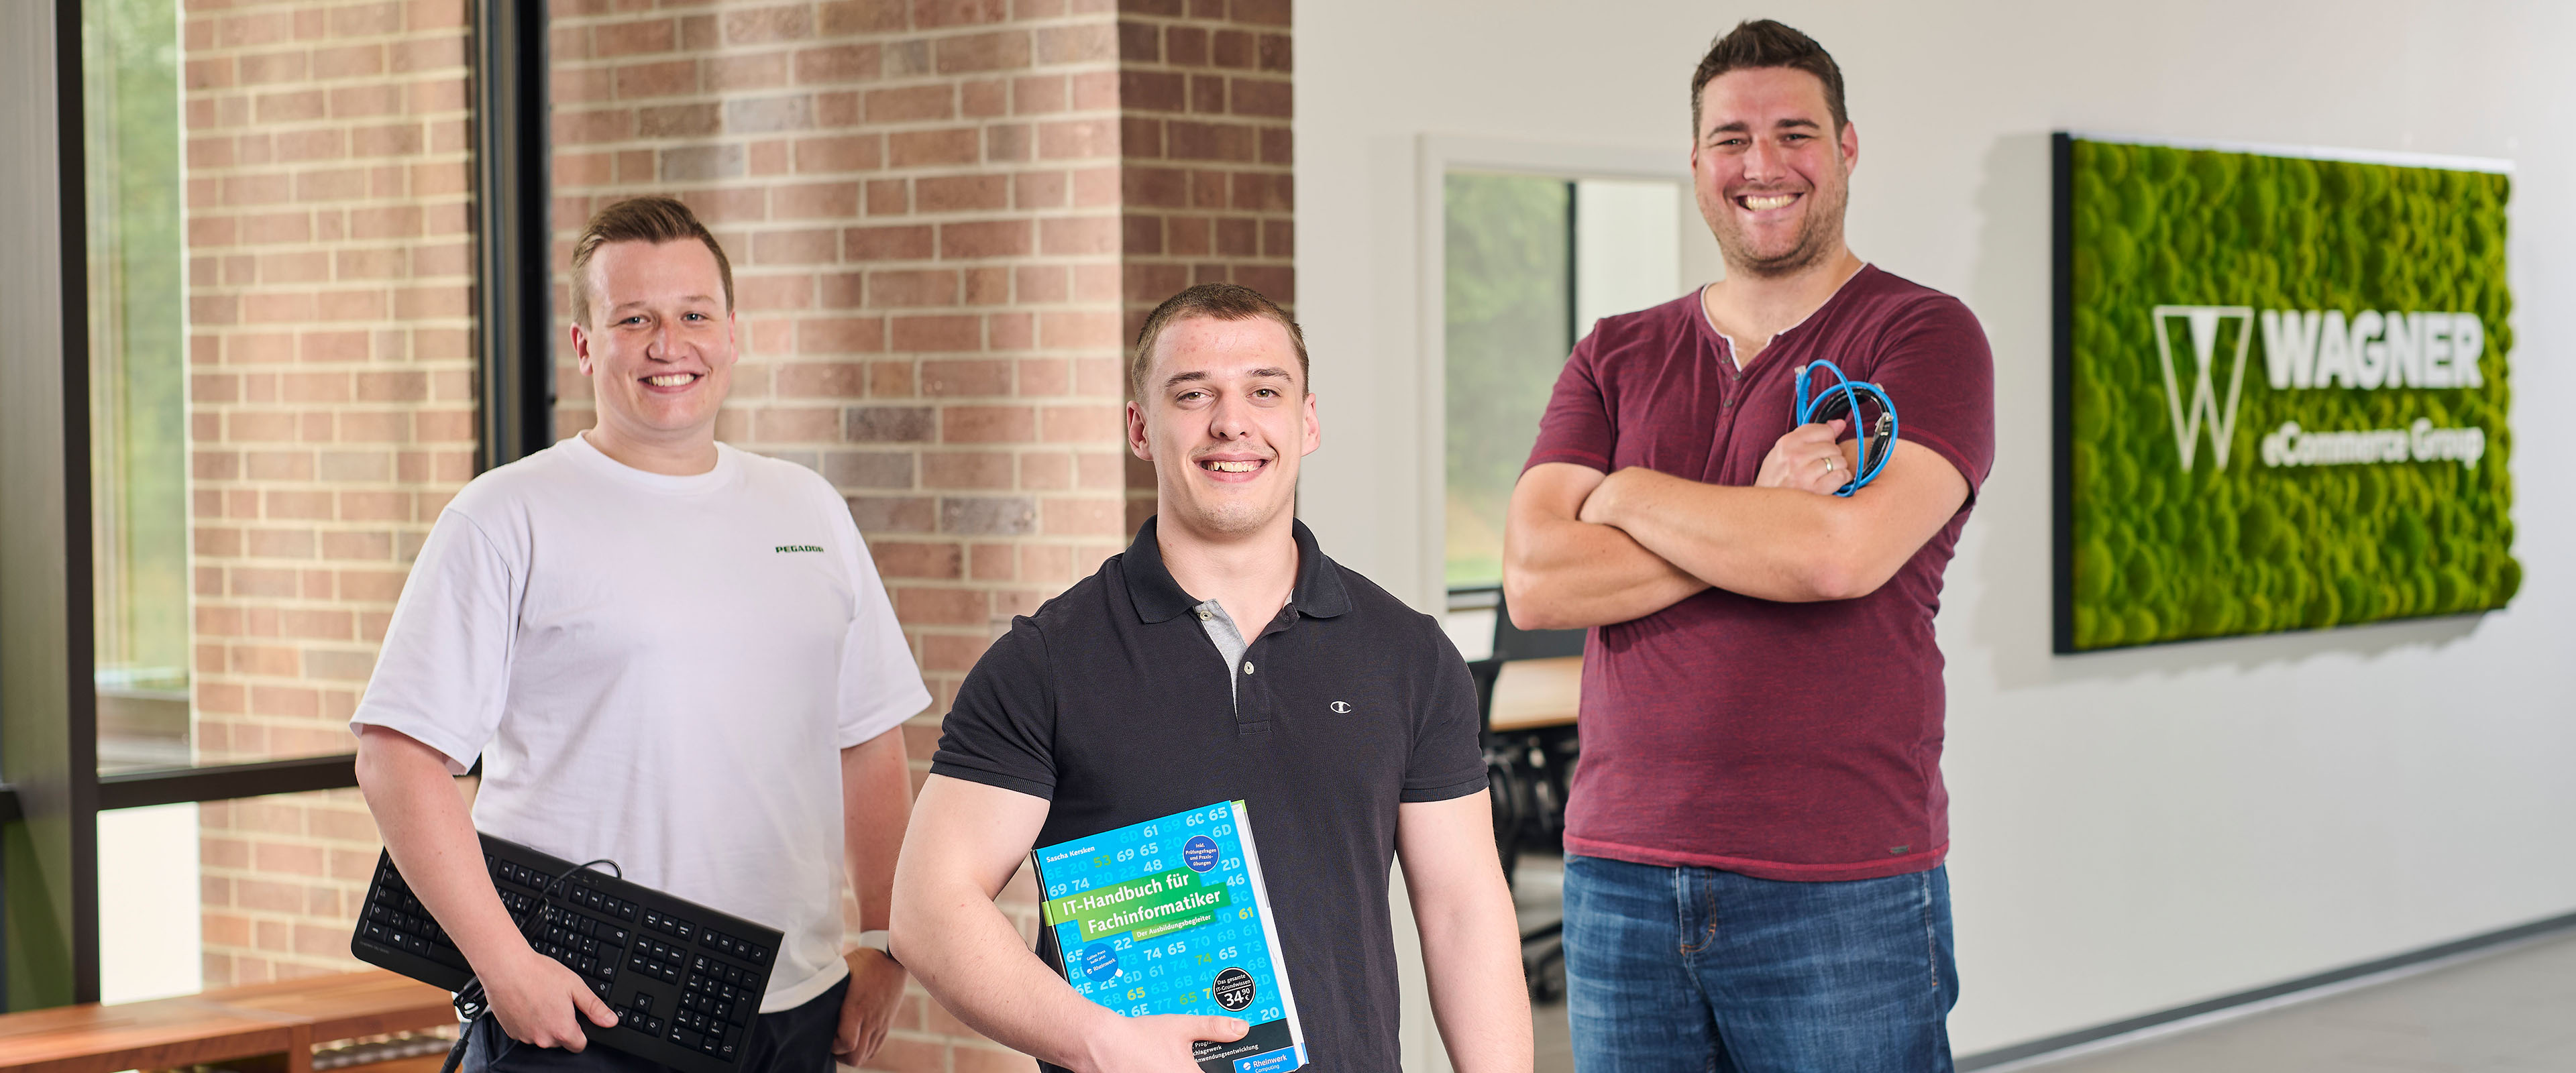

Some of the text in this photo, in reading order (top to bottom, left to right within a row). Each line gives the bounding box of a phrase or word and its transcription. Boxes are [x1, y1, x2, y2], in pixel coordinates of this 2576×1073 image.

[2261, 308, 2484, 390] WAGNER
[2261, 417, 2485, 469] eCommerce Group
[1120, 807, 1228, 844] 6D 61 69 6C 65
[1046, 846, 1095, 862] Sascha Kersken
[1069, 860, 1087, 875] 20
[1093, 854, 1112, 868] 53
[1117, 848, 1135, 862] 69
[1140, 842, 1159, 856] 65
[1212, 824, 1232, 838] 6D
[1049, 883, 1067, 897] 69
[1071, 877, 1090, 891] 74
[1143, 859, 1163, 872] 48
[1221, 857, 1240, 872] 2D
[1063, 872, 1189, 915] IT-Handbuch für
[1226, 872, 1245, 887] 46
[1062, 890, 1248, 946] 69 6C
[1087, 891, 1220, 934] Fachinformatiker
[1148, 914, 1212, 935] Ausbildungsbegleiter
[1067, 948, 1083, 963] 65
[1114, 937, 1133, 952] 22
[1238, 907, 1254, 920] 61
[1143, 947, 1162, 961] 74
[1167, 941, 1186, 955] 65
[1191, 936, 1210, 949] 70
[1218, 929, 1236, 943] 68
[1243, 923, 1258, 936] 61
[1075, 982, 1093, 995] 6E
[1123, 970, 1142, 984] 6D
[1149, 964, 1164, 978] 61
[1194, 952, 1212, 966] 74
[1219, 946, 1238, 960] 65
[1244, 940, 1263, 954] 73
[1093, 958, 1116, 972] Rheinwerk
[1227, 974, 1246, 984] gesamte
[1104, 993, 1122, 1006] 68
[1127, 987, 1146, 1001] 65
[1247, 957, 1267, 970] 68
[1216, 979, 1251, 992] IT-Grundwissen
[1132, 1003, 1150, 1017] 6E
[1179, 992, 1197, 1005] 65
[1203, 988, 1212, 999] 7
[1260, 1007, 1279, 1021] 20
[1193, 1045, 1222, 1056] chlagewerk
[1195, 1044, 1259, 1063] Anwendungsentwicklung
[1253, 1054, 1287, 1068] Rheinwerk
[1255, 1064, 1280, 1073] Computing
